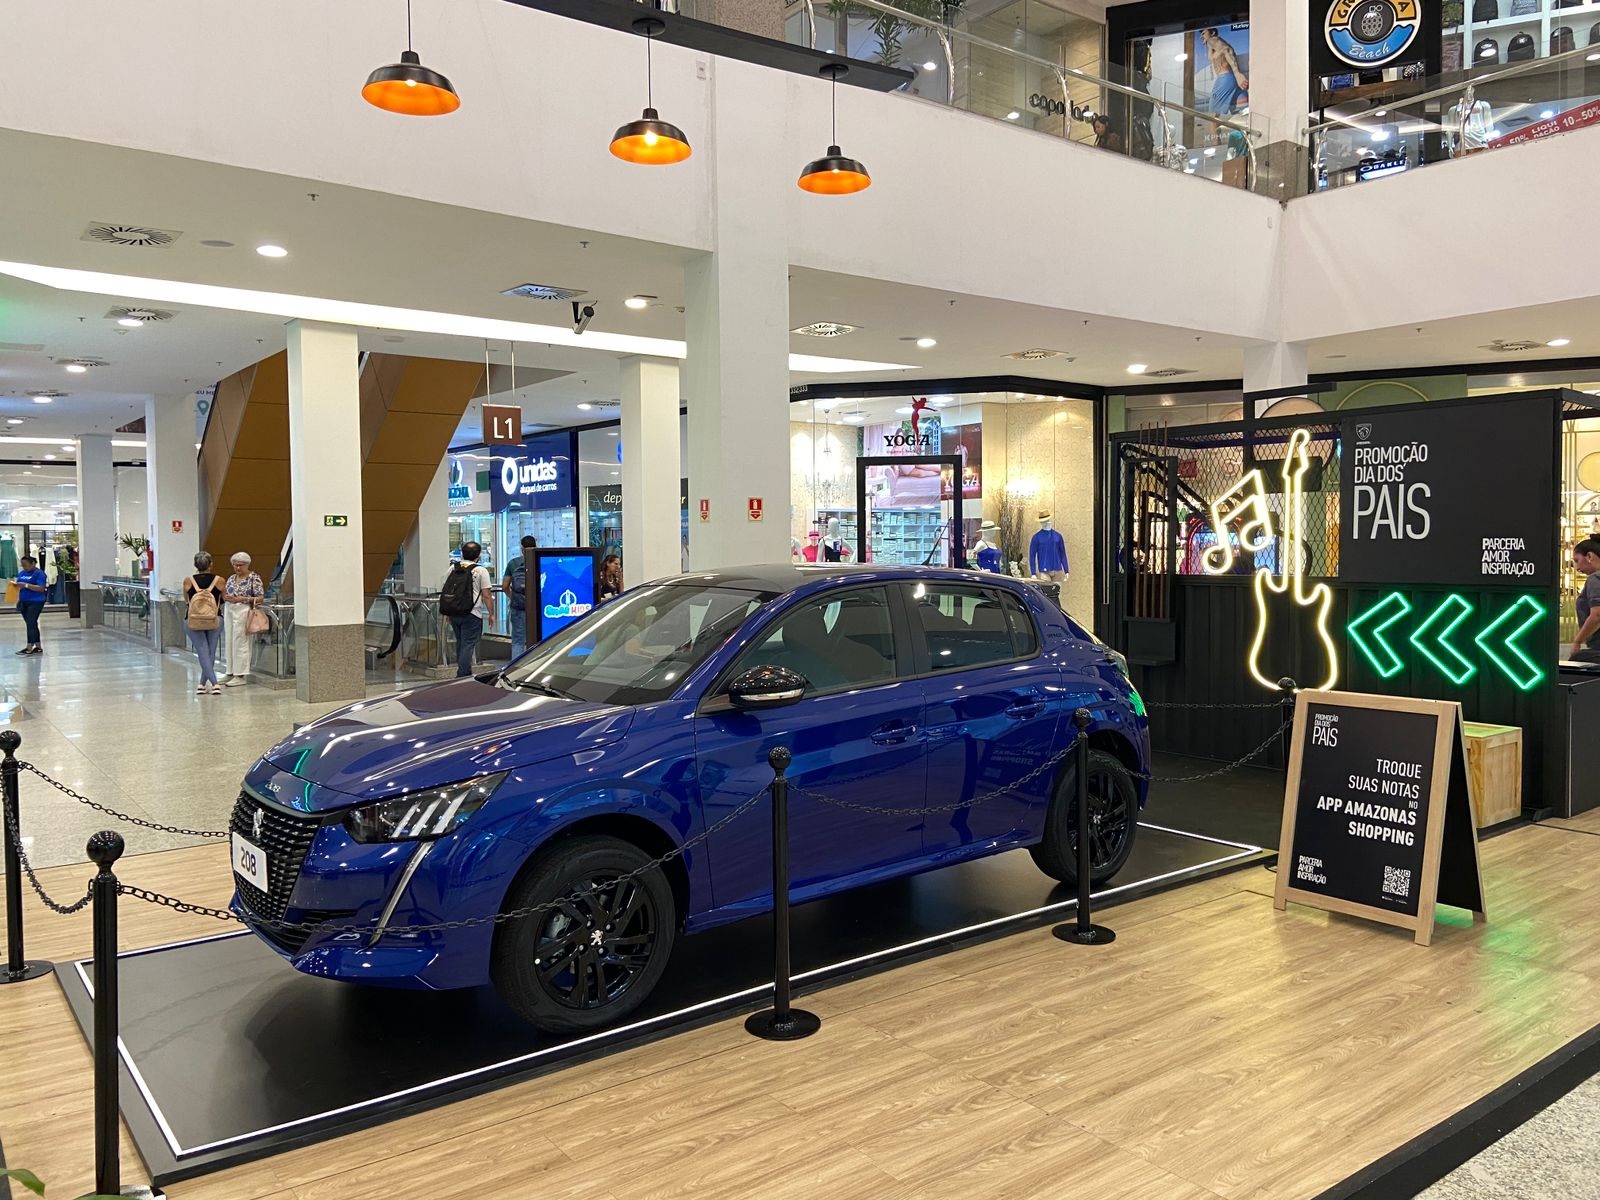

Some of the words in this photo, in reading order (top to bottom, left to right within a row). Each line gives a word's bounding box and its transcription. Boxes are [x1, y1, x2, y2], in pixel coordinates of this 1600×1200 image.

[1348, 42, 1391, 58] Beach
[1531, 120, 1558, 134] LIQUI
[493, 417, 514, 439] L1
[883, 434, 931, 447] YOGA
[1354, 441, 1429, 467] PROMOÇÃO
[519, 457, 557, 484] unidas
[1354, 466, 1376, 483] DIA
[1377, 464, 1404, 483] DOS
[1353, 482, 1432, 540] PAIS
[1482, 537, 1525, 550] PARCERIA
[1481, 550, 1510, 562] AMOR
[1481, 560, 1535, 578] INSPIRAÇÃO
[1315, 713, 1339, 723] PROMOÇÃO
[1321, 720, 1331, 728] DOS
[1312, 725, 1339, 747] PAIS
[1376, 758, 1422, 779] TROQUE
[1348, 774, 1379, 793] SUAS
[1381, 779, 1420, 799] NOTAS
[1316, 795, 1343, 812] APP
[1344, 800, 1417, 826] AMAZONAS
[1408, 800, 1418, 810] NO
[1348, 820, 1415, 847] SHOPPING
[240, 846, 256, 876] 208
[1298, 863, 1314, 873] AMOR
[1299, 854, 1323, 868] PARCERIA
[1297, 870, 1327, 884] INSPIRAÇÃO
